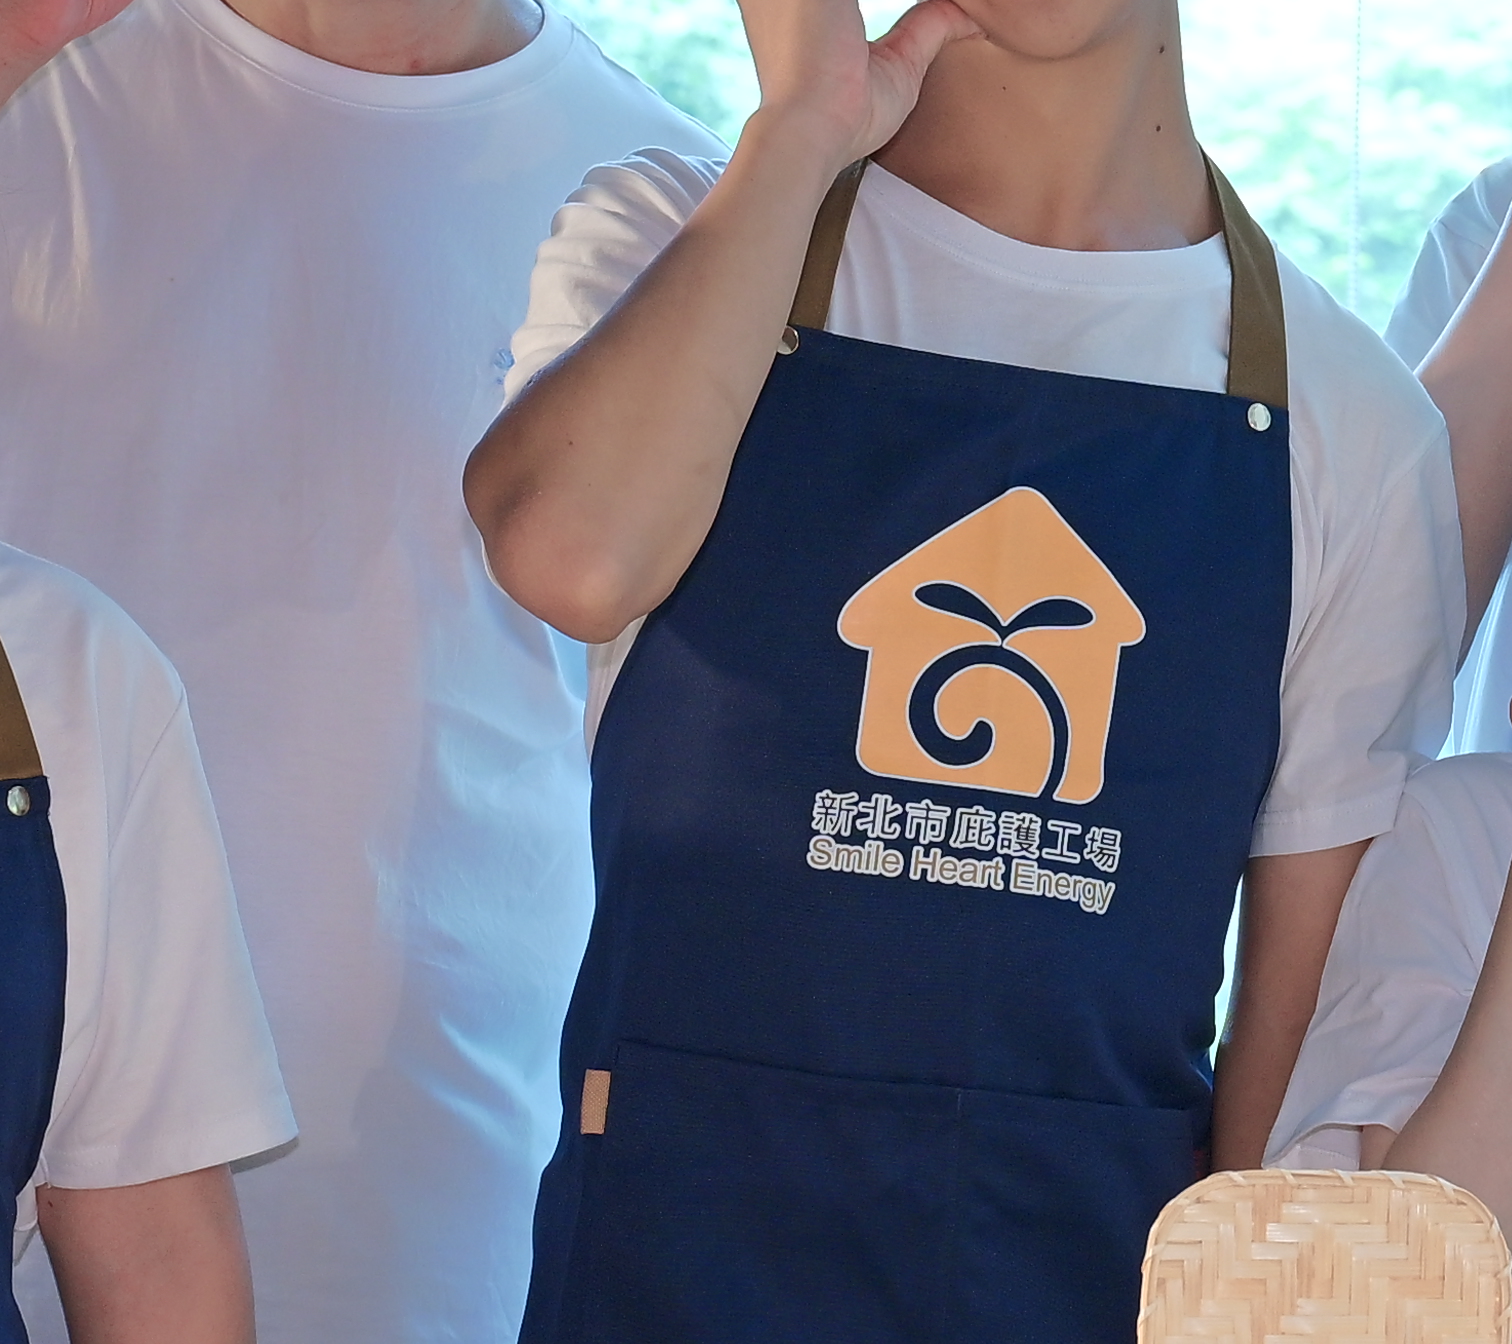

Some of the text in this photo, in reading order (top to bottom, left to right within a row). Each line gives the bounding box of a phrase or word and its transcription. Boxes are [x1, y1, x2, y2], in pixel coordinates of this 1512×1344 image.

[811, 789, 1122, 873] 新北市庇護工場
[807, 835, 1116, 915] Smile Heart Energy
